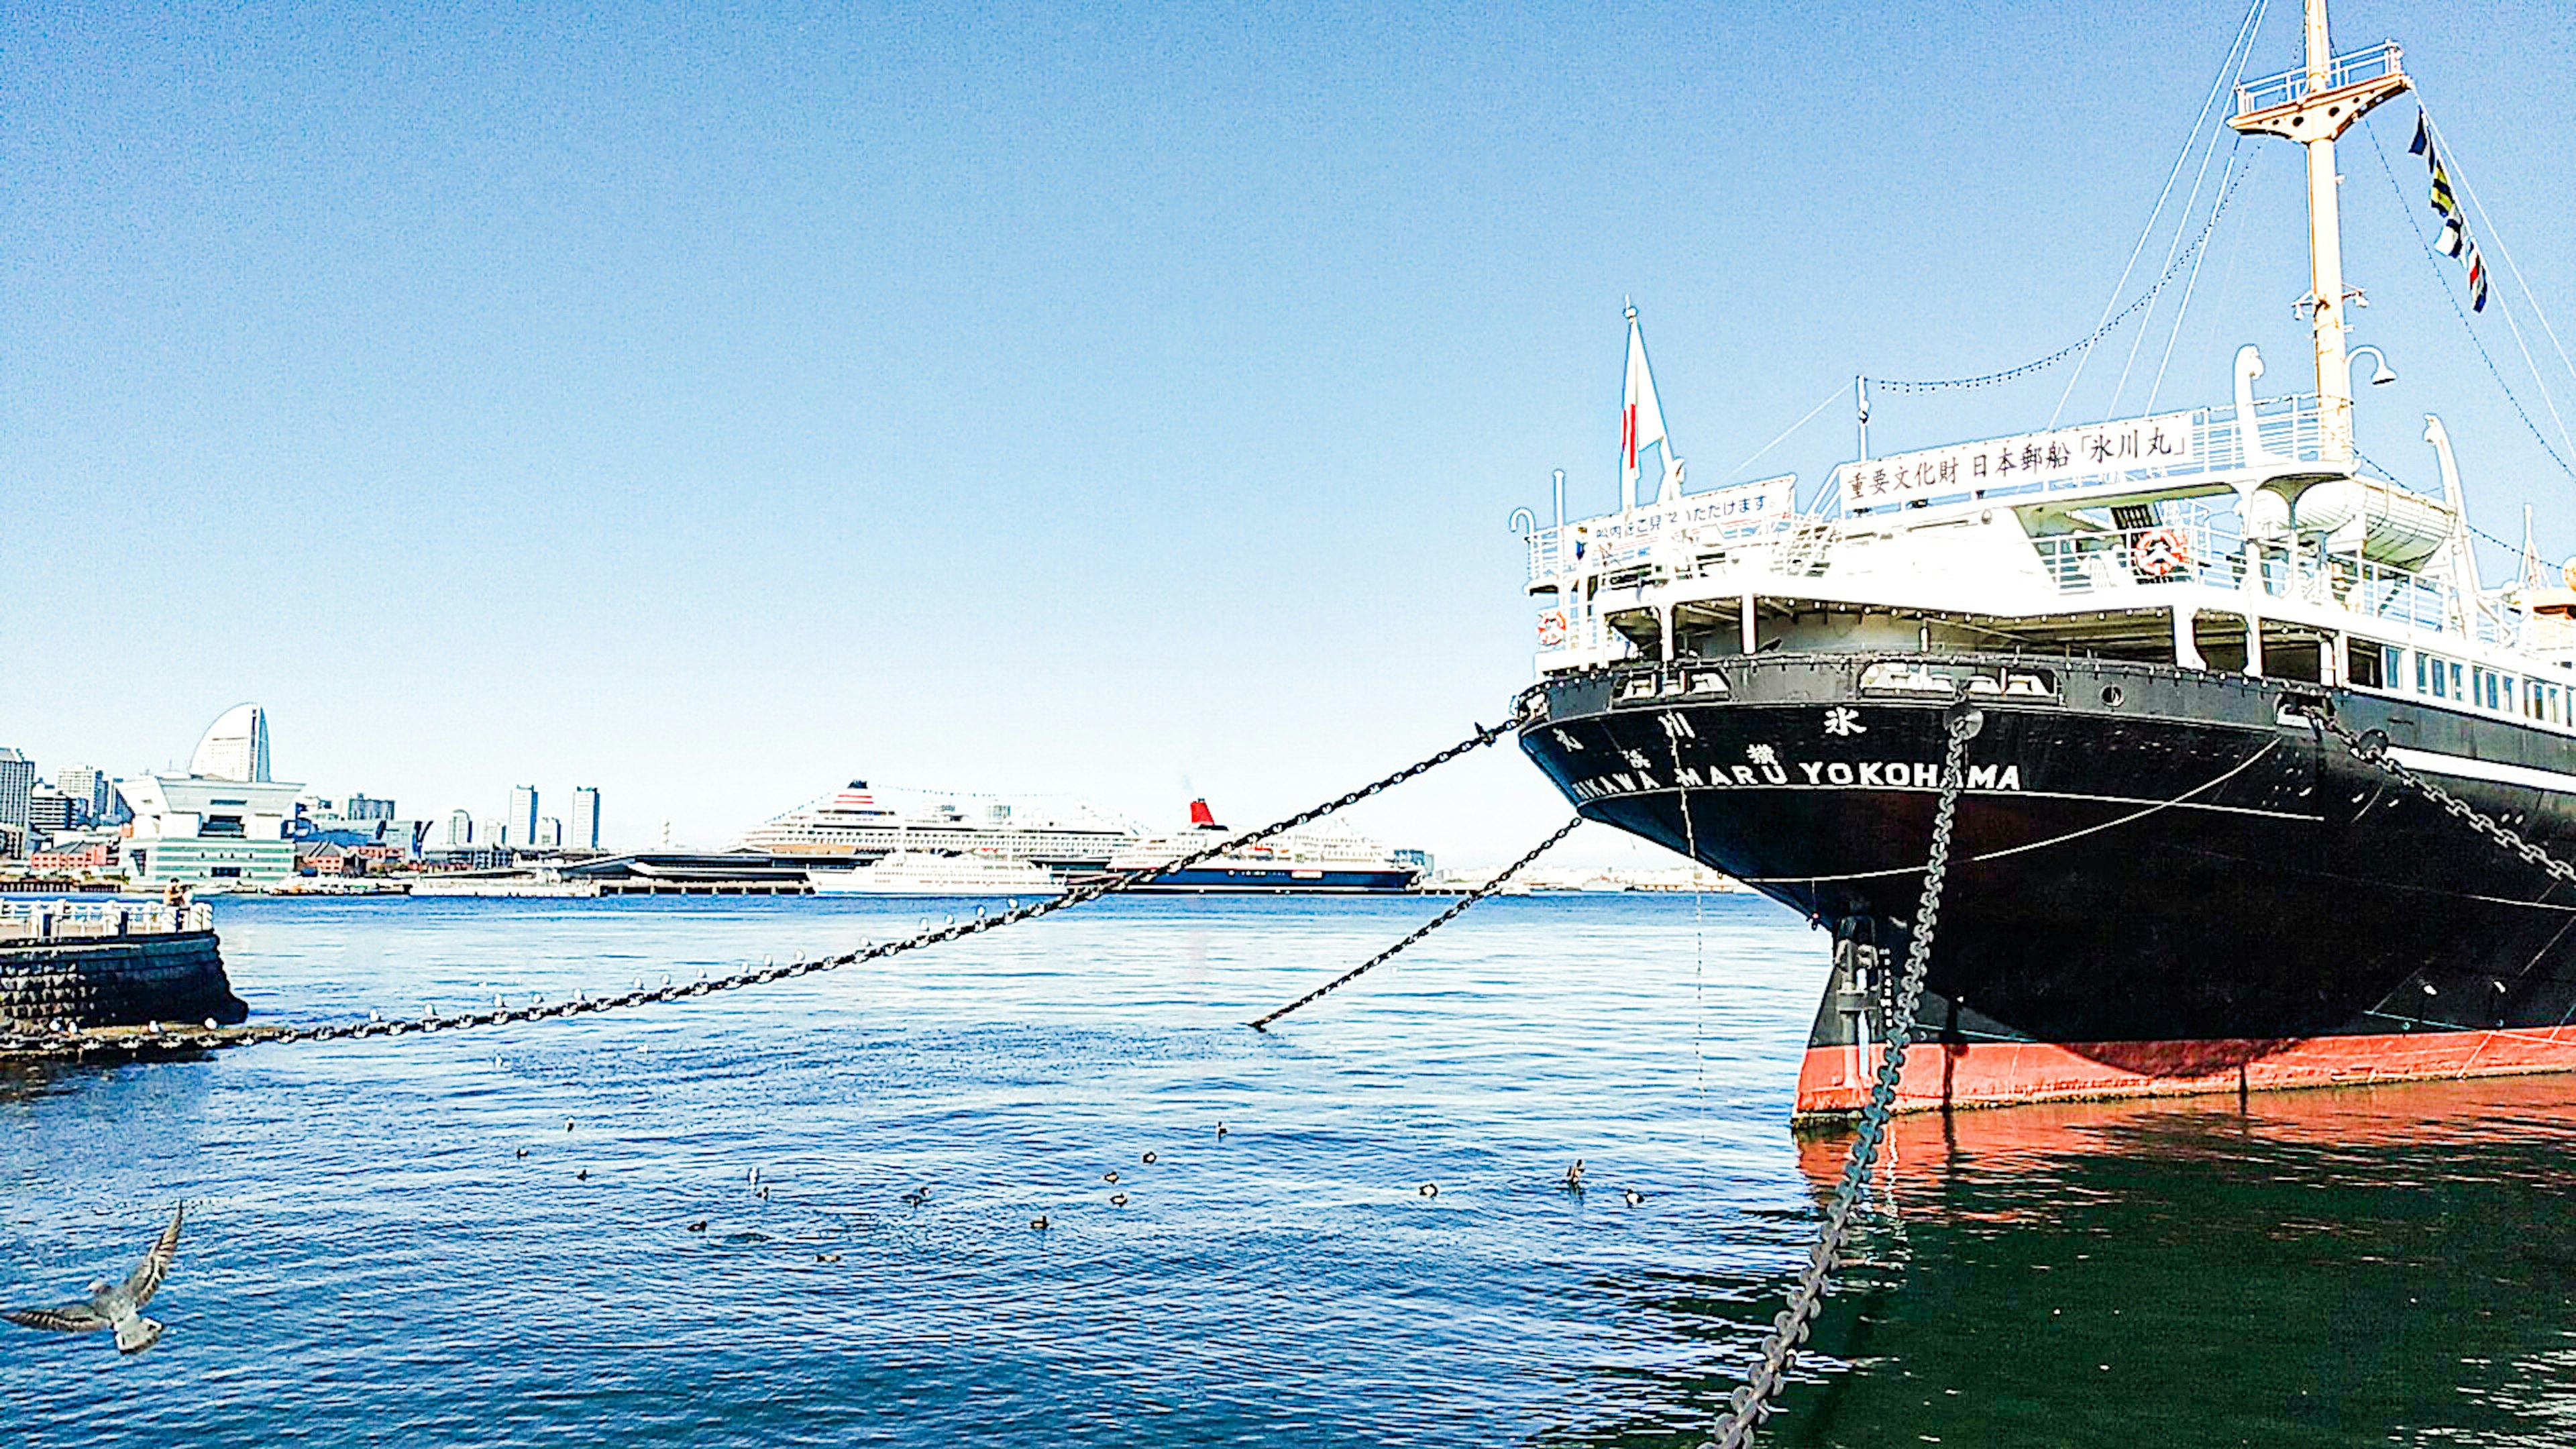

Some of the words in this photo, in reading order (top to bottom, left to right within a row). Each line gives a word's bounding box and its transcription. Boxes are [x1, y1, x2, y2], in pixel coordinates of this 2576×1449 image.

[1847, 455, 1959, 500] 重要文化財
[1673, 765, 1788, 787] MARU
